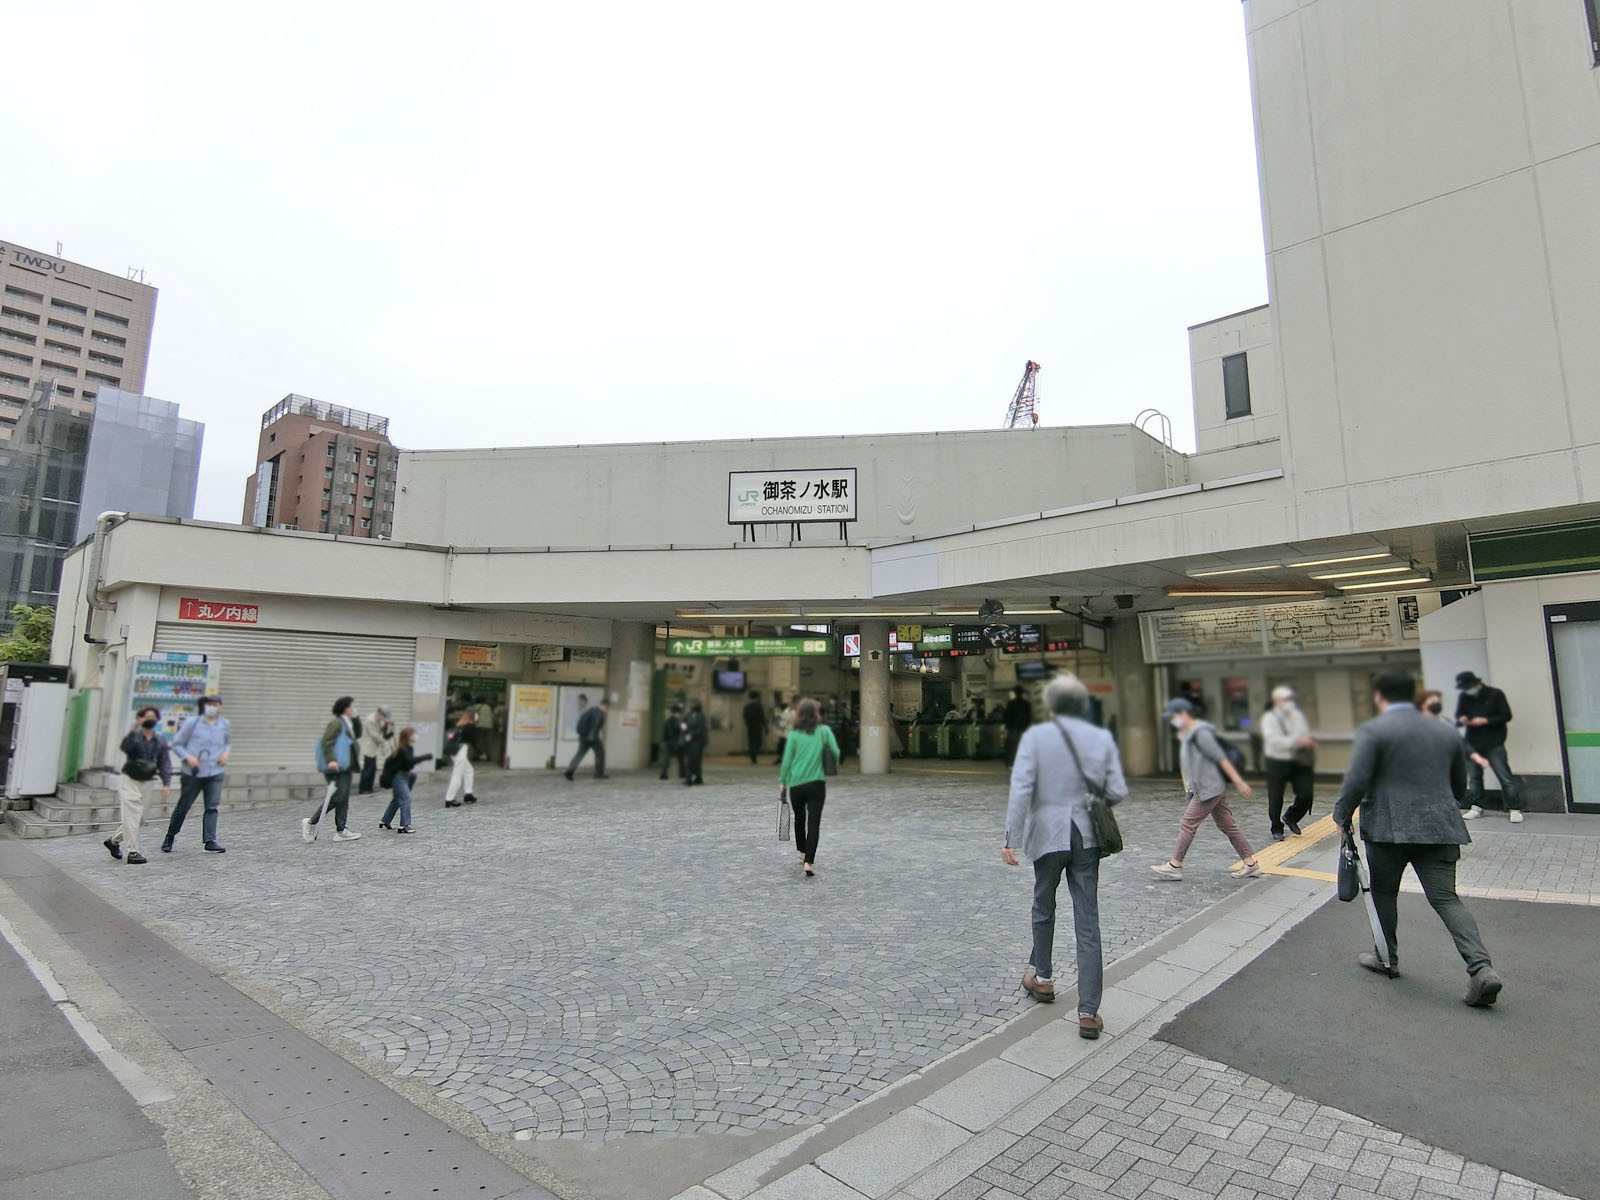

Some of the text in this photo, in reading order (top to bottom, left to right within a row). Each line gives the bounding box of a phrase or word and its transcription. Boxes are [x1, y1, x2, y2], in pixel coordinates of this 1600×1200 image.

[13, 250, 66, 274] TMDU
[738, 490, 759, 503] JR
[762, 479, 849, 501] 御茶ノ水駅
[761, 504, 849, 516] OCHANOMIZU STATION
[197, 604, 258, 622] 丸ノ内線
[685, 640, 703, 651] JR
